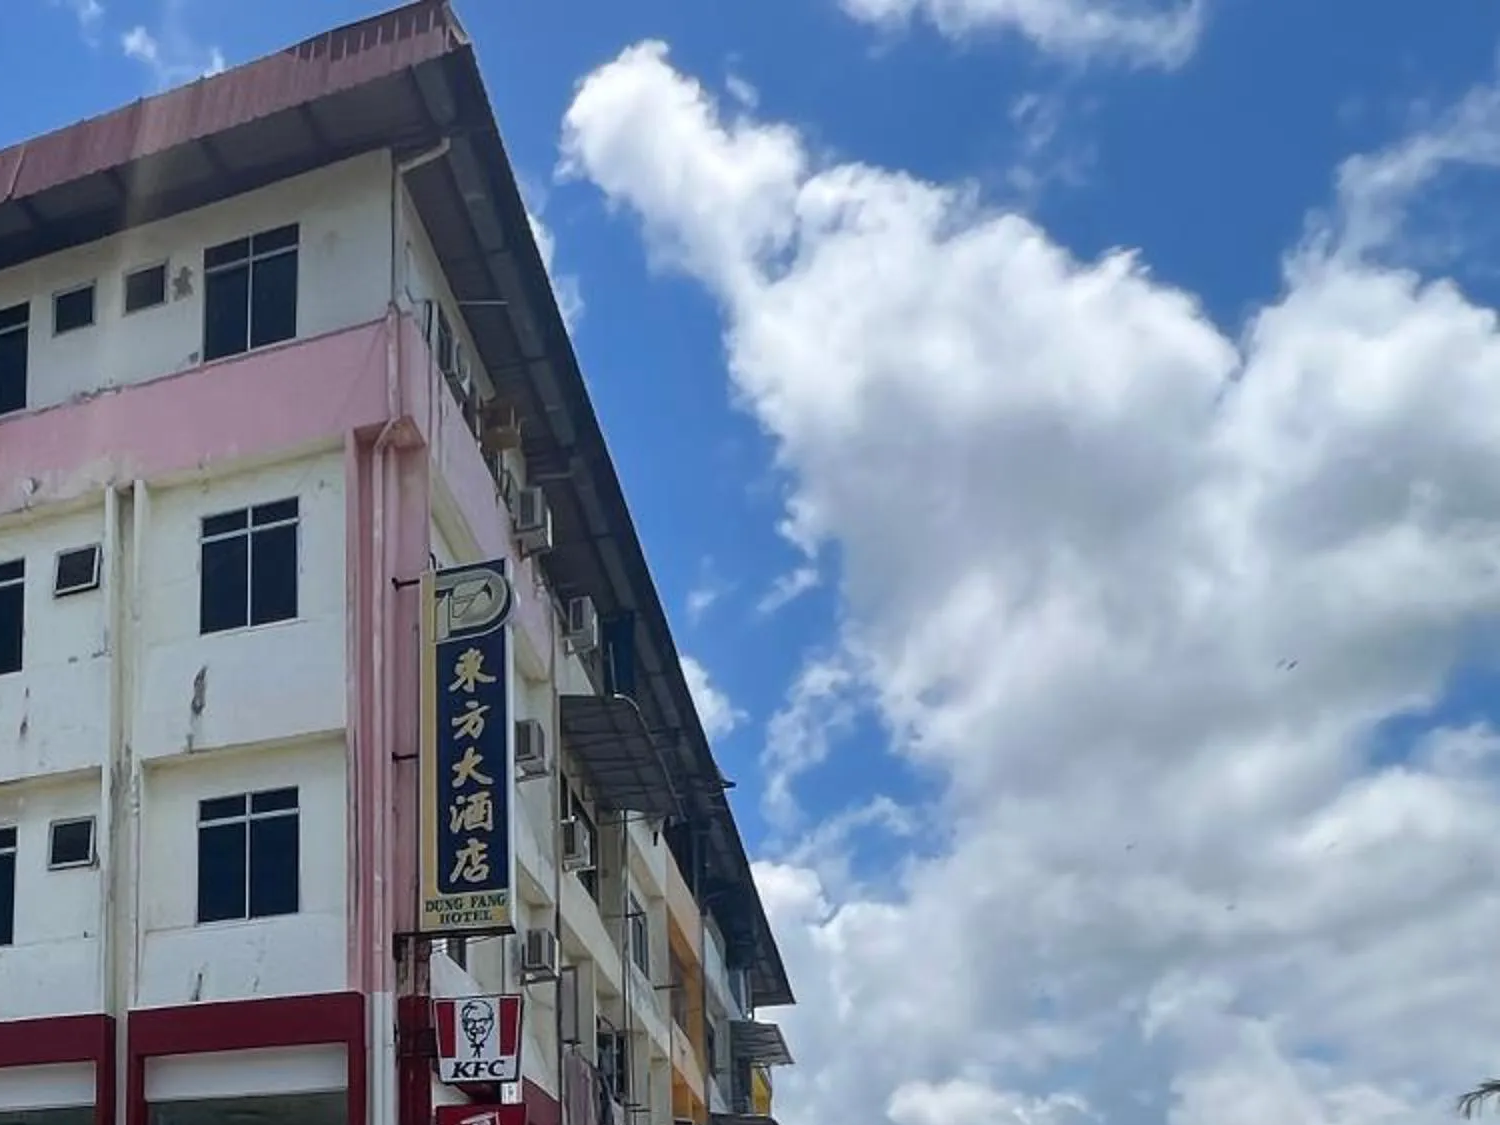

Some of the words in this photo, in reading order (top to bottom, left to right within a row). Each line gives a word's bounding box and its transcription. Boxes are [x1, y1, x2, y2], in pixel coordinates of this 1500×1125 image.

[425, 898, 463, 913] DUNG
[470, 894, 506, 909] FANG
[439, 910, 492, 924] HOTEL
[451, 1060, 505, 1079] KFC
